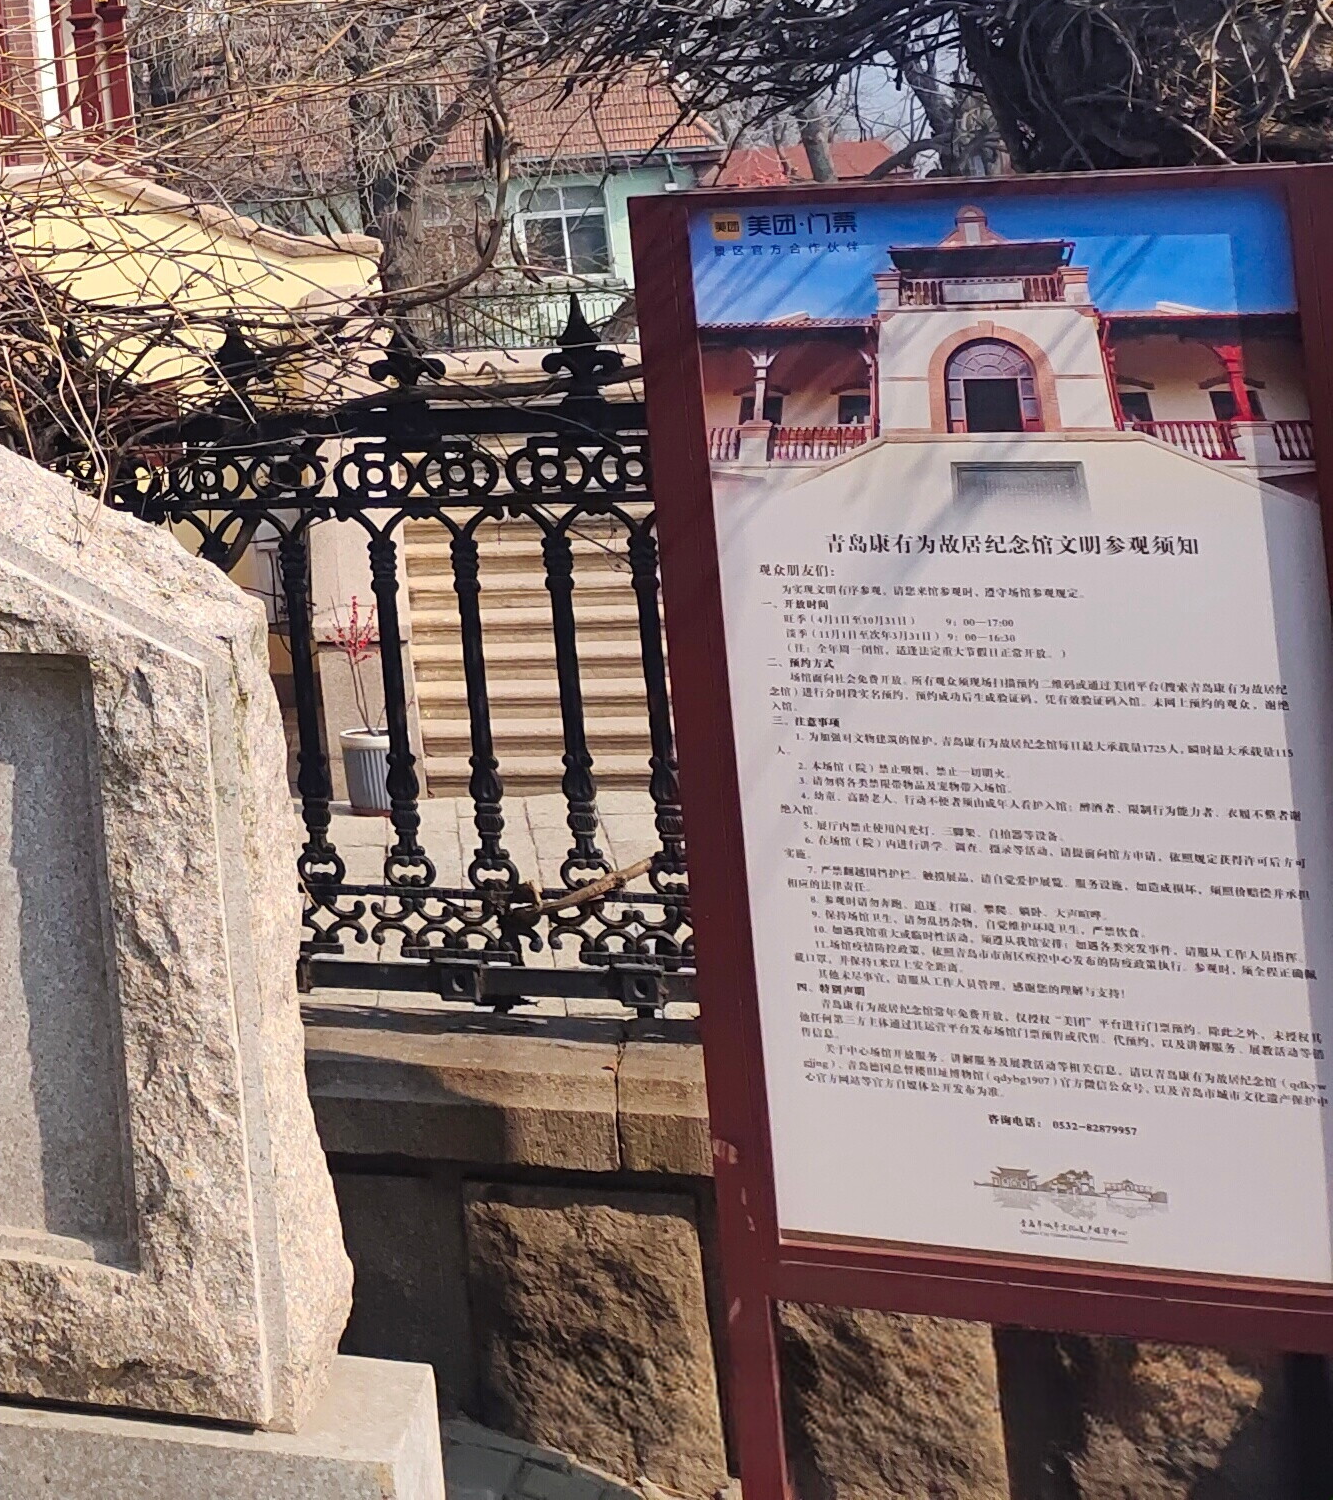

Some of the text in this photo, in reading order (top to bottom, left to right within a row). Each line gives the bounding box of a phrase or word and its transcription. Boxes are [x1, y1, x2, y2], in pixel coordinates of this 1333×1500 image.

[714, 240, 860, 257] 景区官方合作伙伴
[824, 531, 1199, 557] 青岛康有为故居纪念馆文明参观须知
